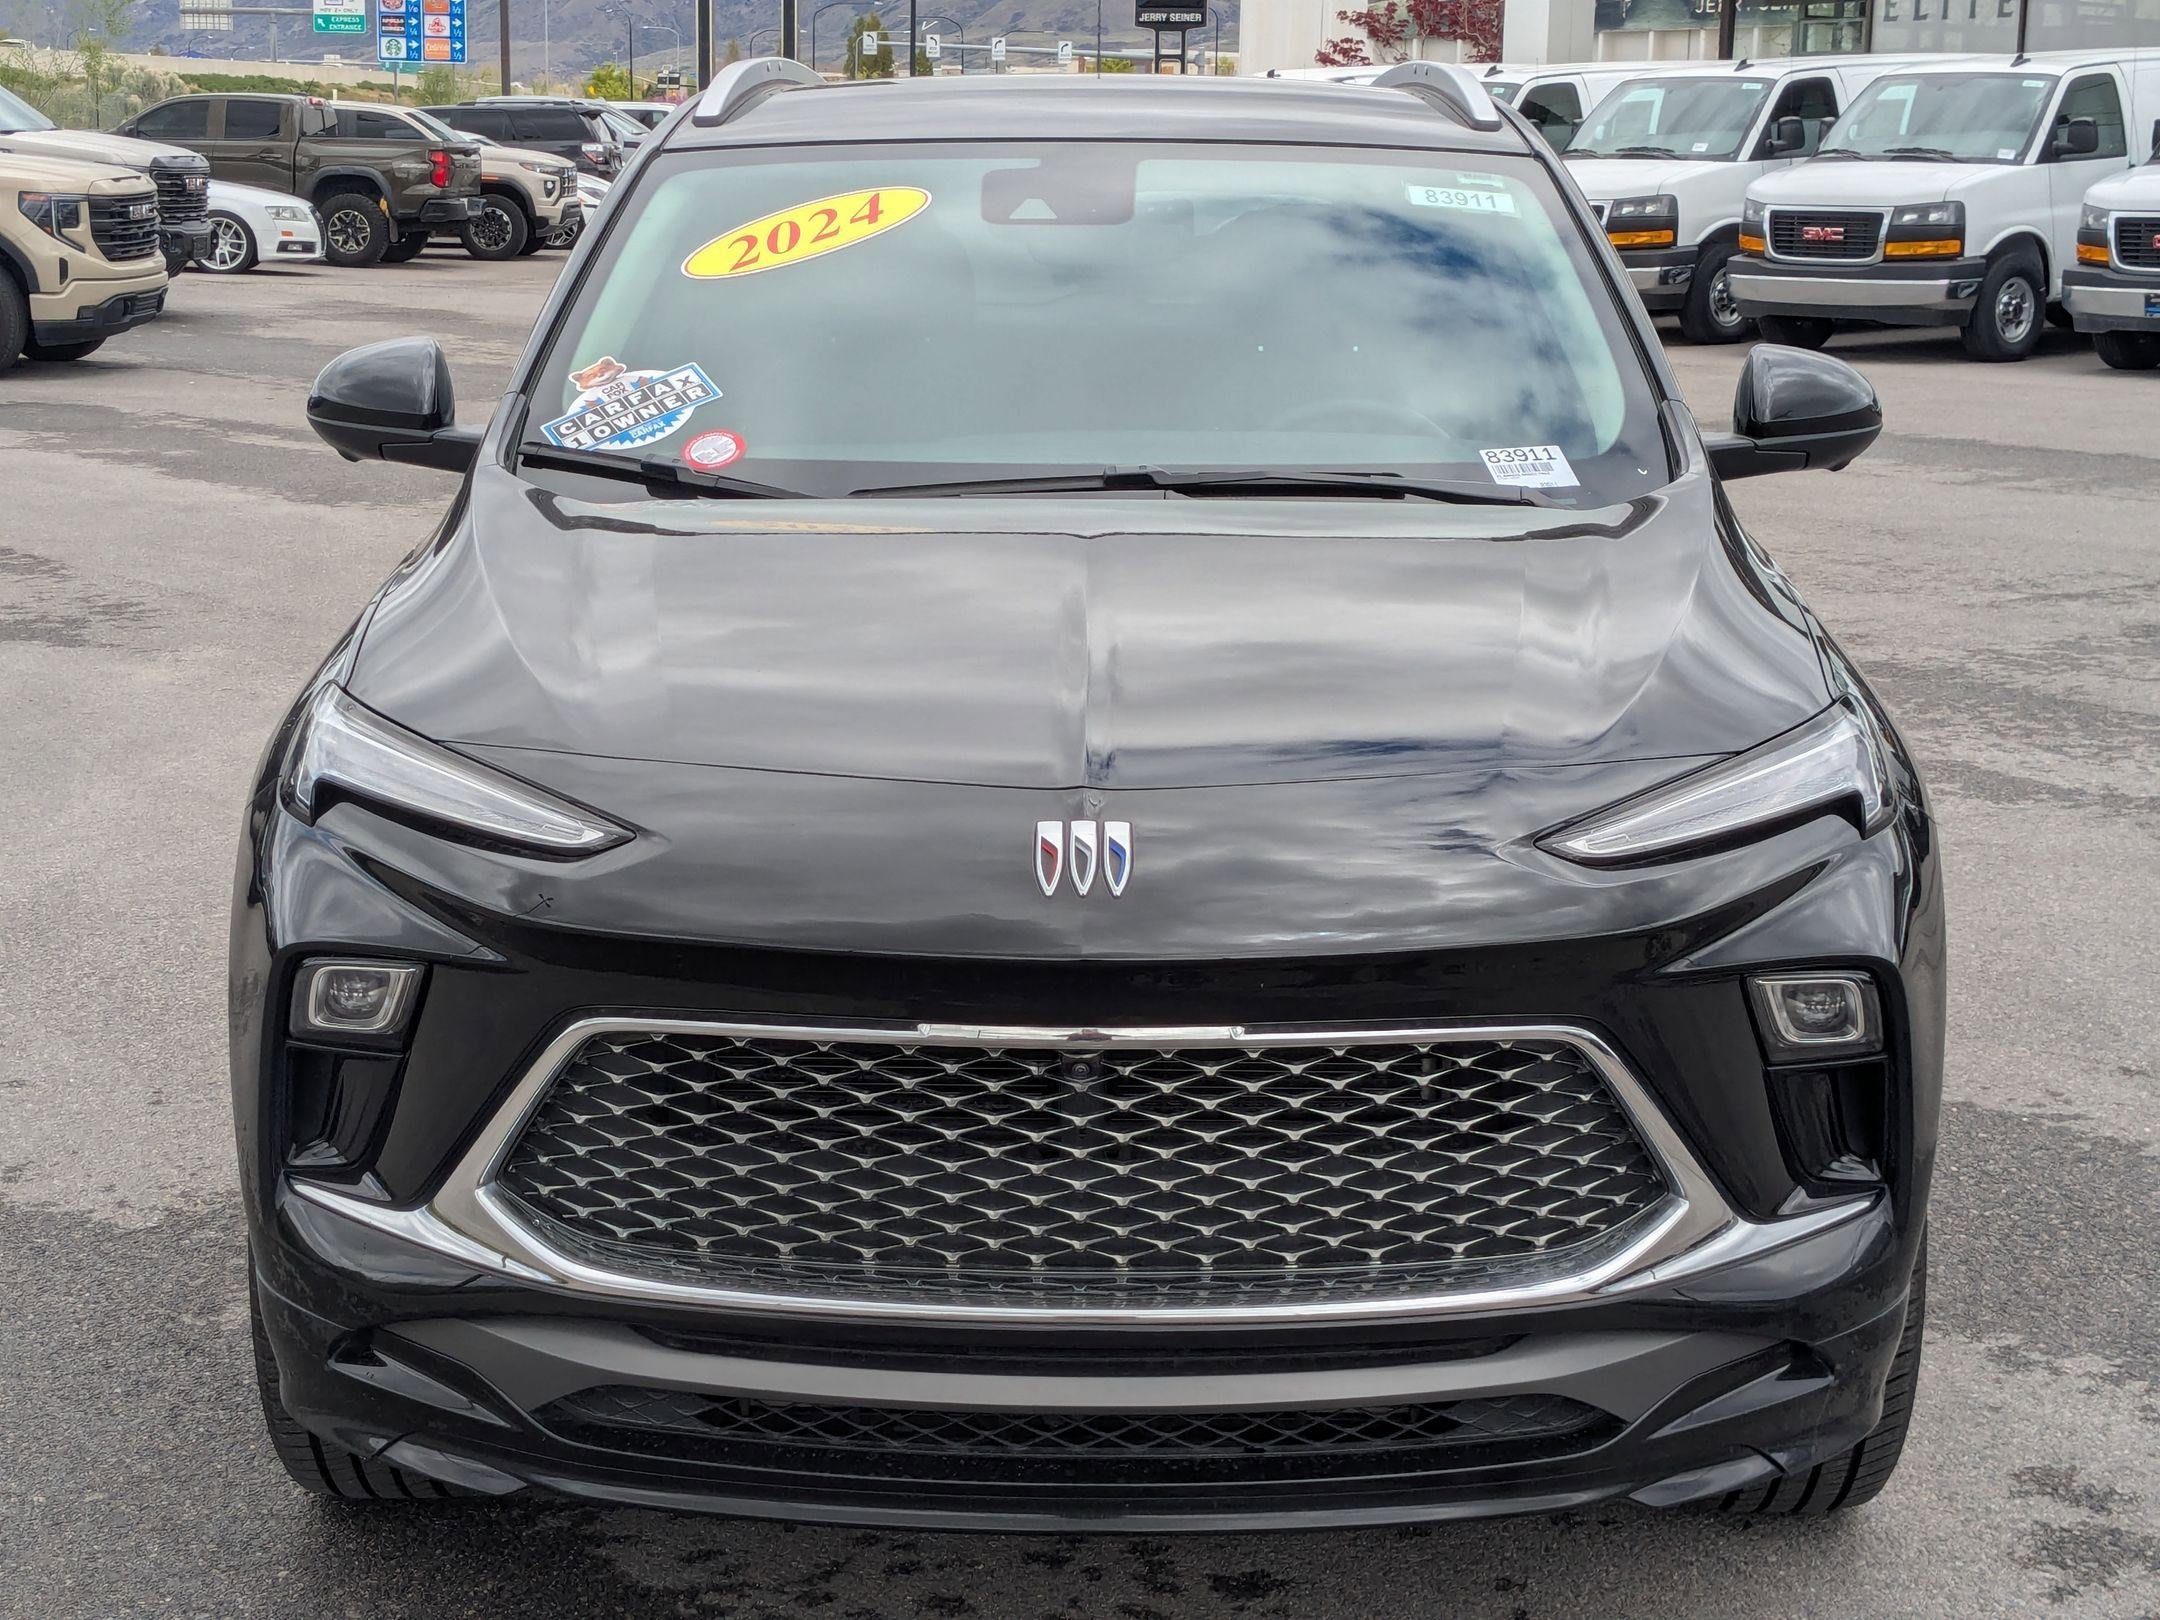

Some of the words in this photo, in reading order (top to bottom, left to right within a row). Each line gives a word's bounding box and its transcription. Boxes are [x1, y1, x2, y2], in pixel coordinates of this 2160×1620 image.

[1139, 13, 1167, 22] JERRY
[1169, 13, 1202, 22] SEINER
[1425, 189, 1497, 209] 83911
[727, 192, 884, 272] 2024
[1802, 226, 1845, 240] GMC
[602, 382, 626, 394] CAR
[559, 375, 695, 436] CARFAX
[593, 386, 707, 441] OWNER
[1485, 447, 1557, 464] 83911
